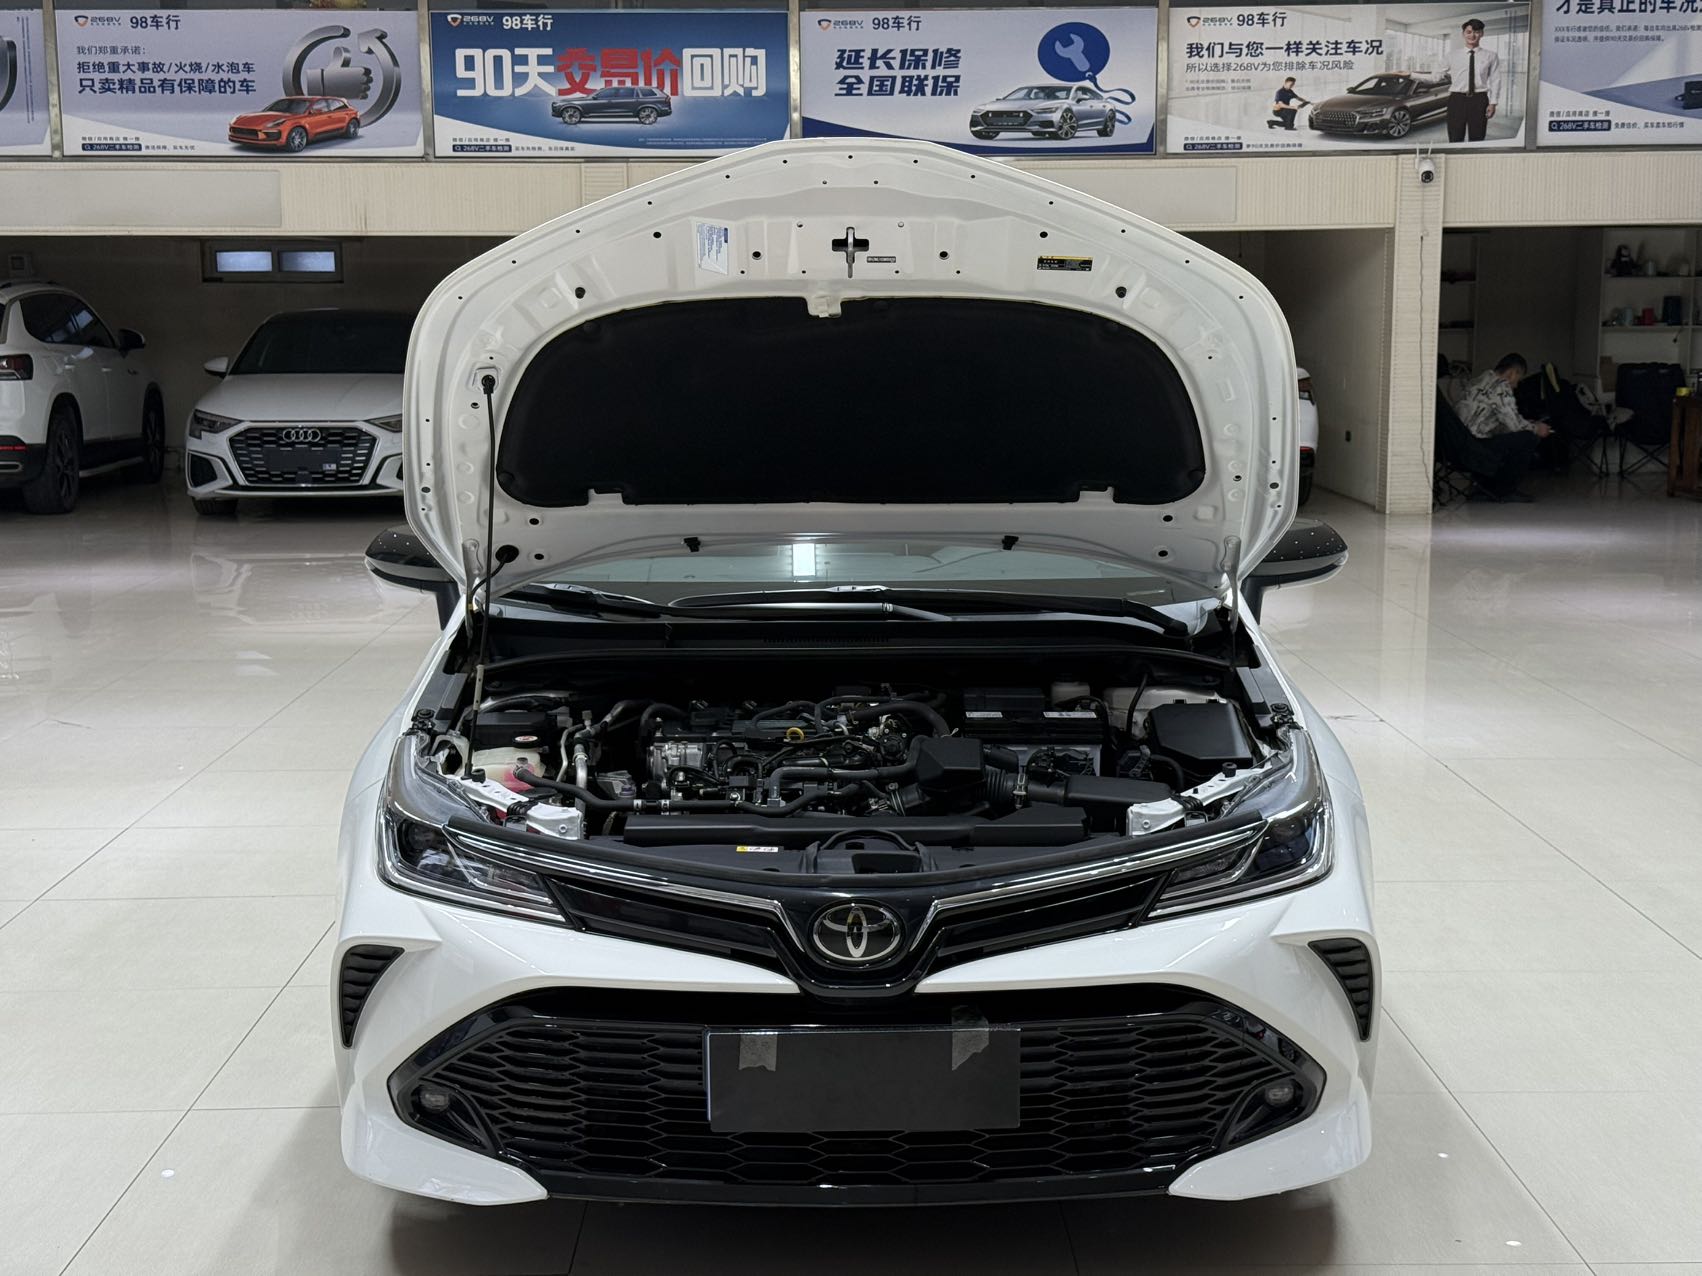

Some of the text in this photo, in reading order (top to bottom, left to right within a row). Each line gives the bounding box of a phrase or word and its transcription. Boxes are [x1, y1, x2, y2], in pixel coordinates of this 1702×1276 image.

[1556, 0, 1702, 14] 才是真正的车况
[130, 14, 181, 30] 98车行
[502, 14, 554, 31] 98车行
[872, 15, 922, 31] 98车行
[1237, 12, 1287, 28] 98车行
[1185, 39, 1384, 59] 我们与您一样关注车况
[834, 48, 961, 70] 延长保修
[1185, 60, 1354, 73] 所以选择268V为您排除车况风险
[76, 61, 256, 74] 拒绝重大事故/火烧/水泡车
[455, 47, 767, 97] 90天交易价回购
[78, 77, 257, 95] 只卖精品有保障的车
[834, 74, 961, 96] 全国联保
